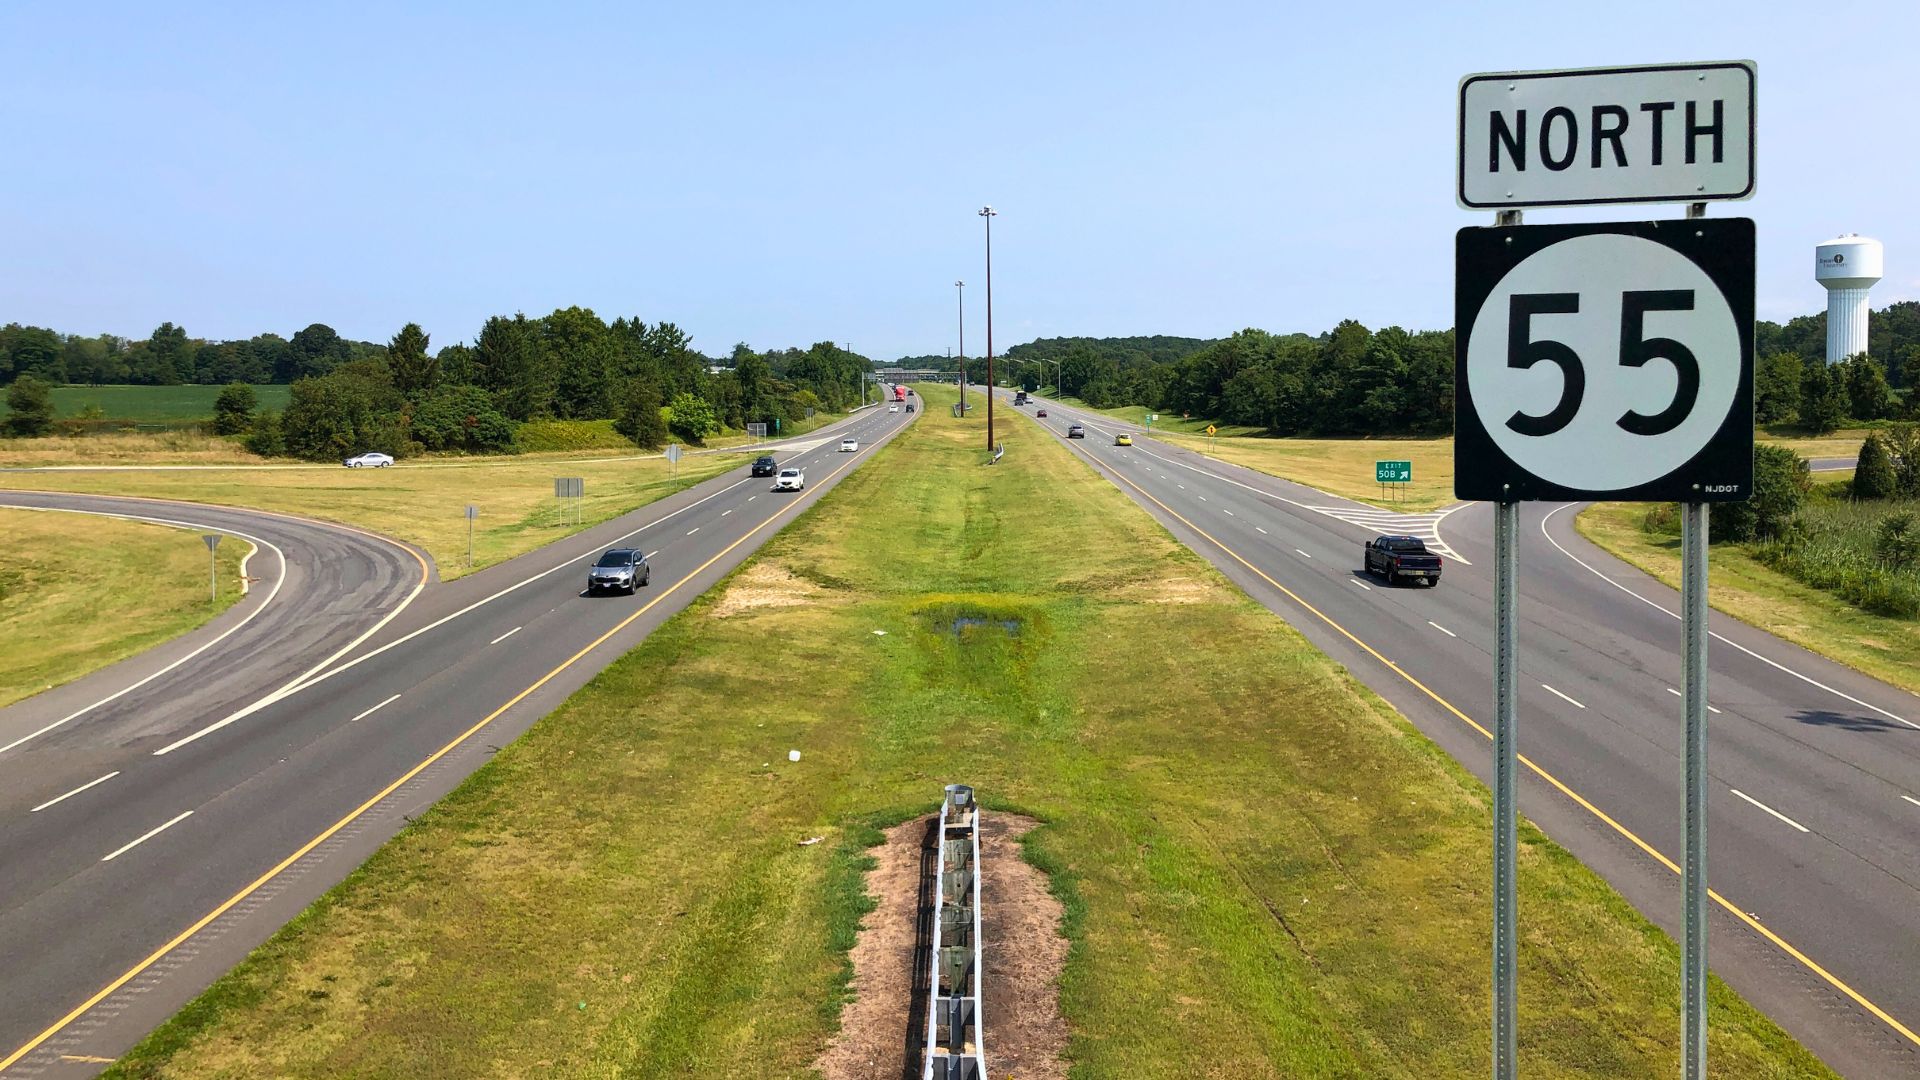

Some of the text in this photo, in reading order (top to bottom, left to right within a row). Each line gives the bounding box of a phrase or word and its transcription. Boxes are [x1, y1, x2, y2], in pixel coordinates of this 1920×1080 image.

[1489, 99, 1724, 173] NORTH
[1504, 289, 1700, 437] 55
[1378, 470, 1396, 479] 50B
[1704, 484, 1739, 493] NJDOT
